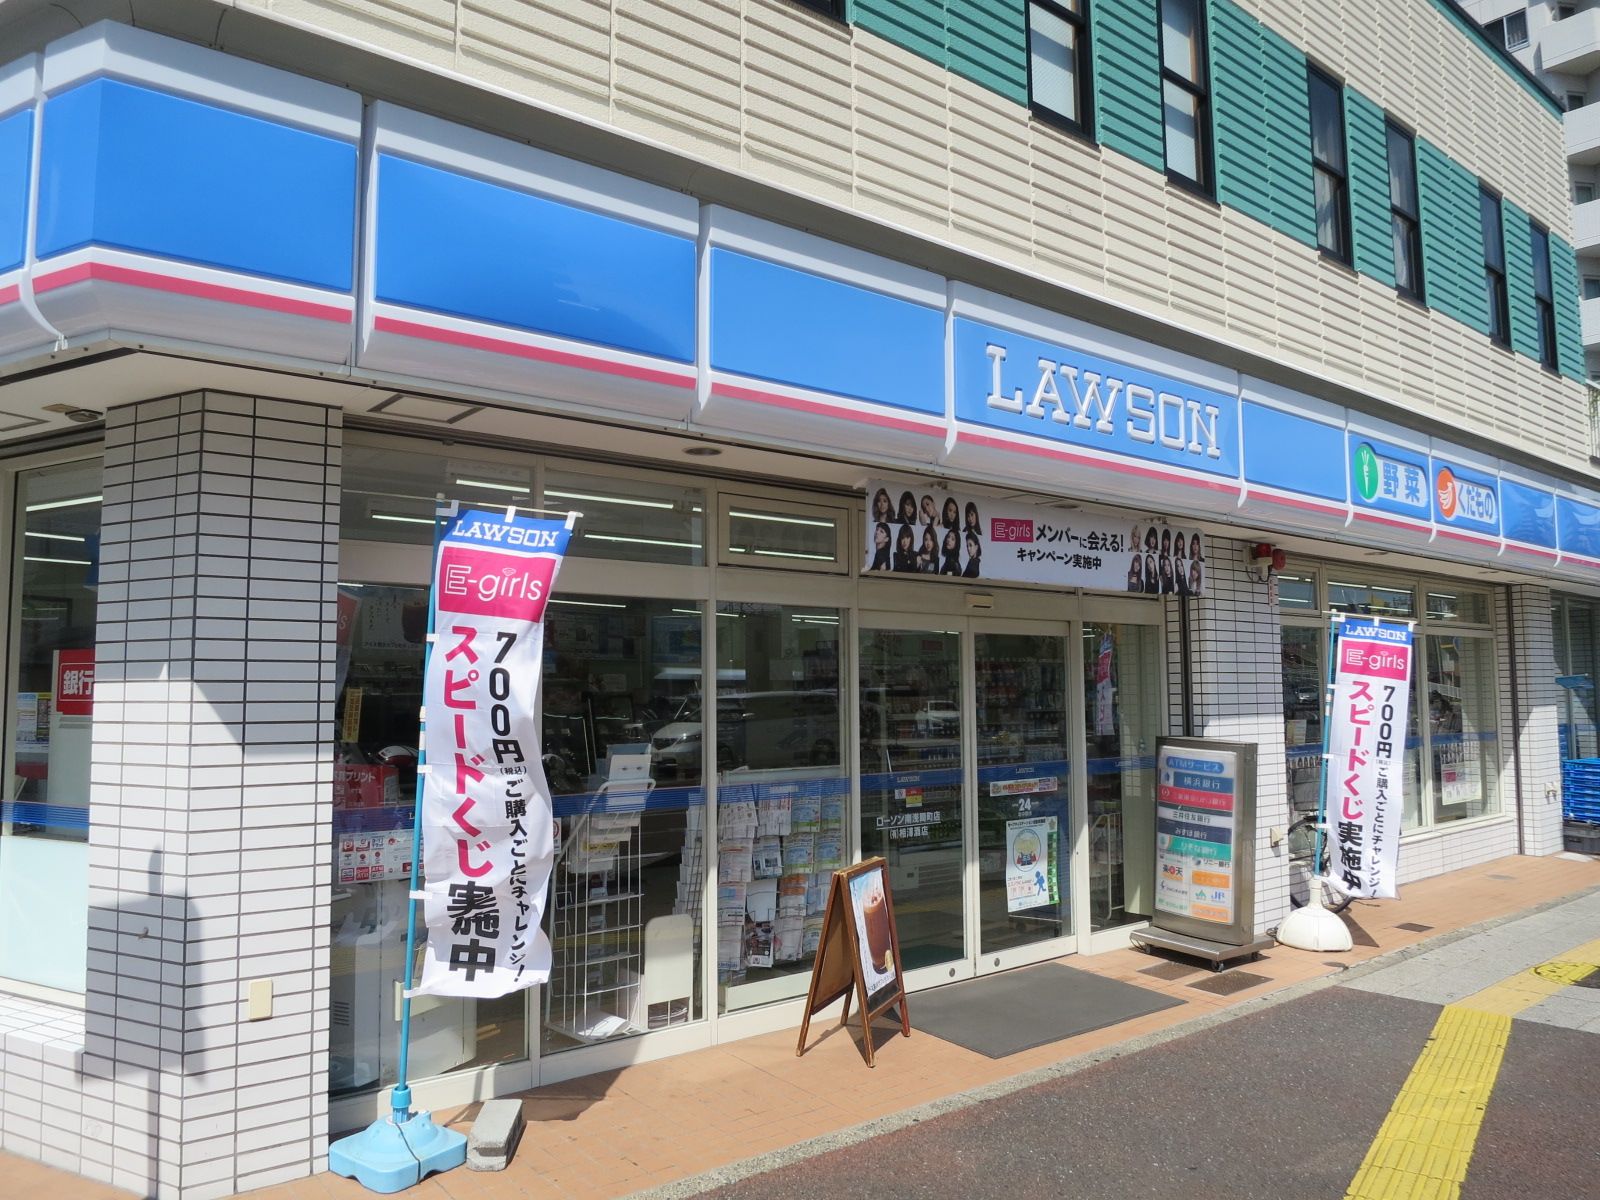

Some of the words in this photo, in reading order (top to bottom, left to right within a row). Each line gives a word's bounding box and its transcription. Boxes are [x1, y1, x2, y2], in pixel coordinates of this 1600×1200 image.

[986, 342, 1221, 460] LAWSON
[1382, 462, 1421, 503] 野菜
[1458, 484, 1494, 519] くだもの
[452, 520, 559, 548] LAWSON
[994, 521, 1031, 541] E-girls
[1017, 547, 1102, 570] キャンペーン実施中
[444, 564, 543, 602] E-girls
[1345, 624, 1407, 641] LAWSON
[1345, 648, 1405, 670] E-girls
[63, 670, 95, 695] 銀行
[1338, 680, 1375, 891] スピードくじ実施中
[444, 626, 500, 982] スピードくじ実施中
[1018, 798, 1032, 812] 24
